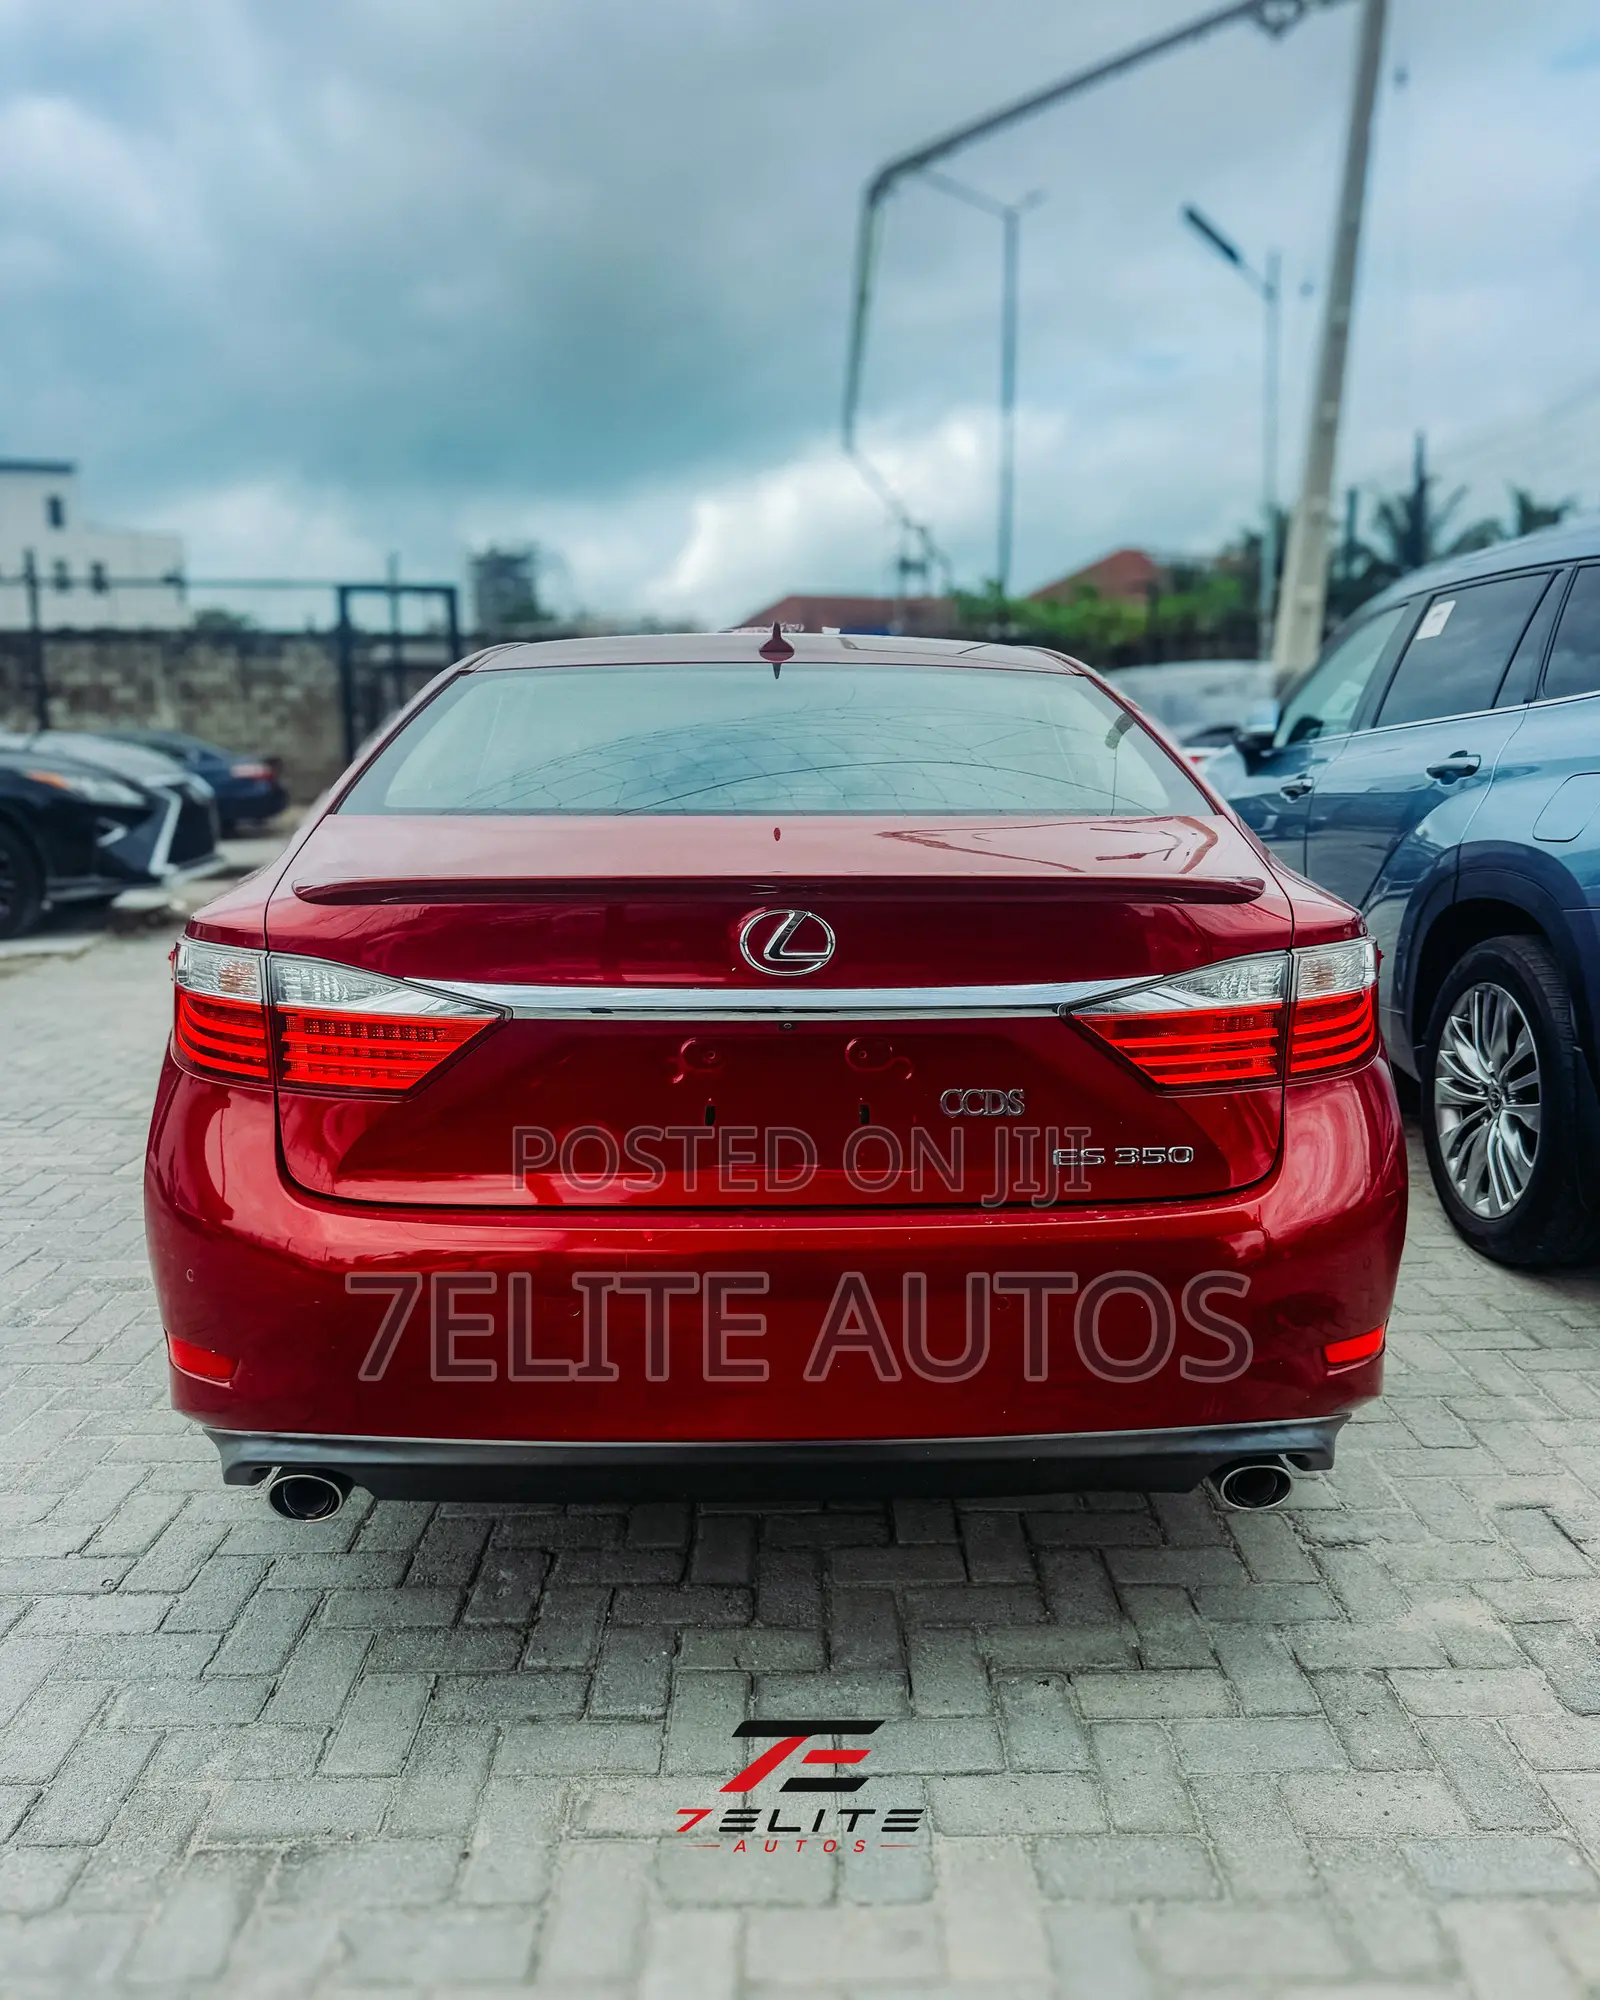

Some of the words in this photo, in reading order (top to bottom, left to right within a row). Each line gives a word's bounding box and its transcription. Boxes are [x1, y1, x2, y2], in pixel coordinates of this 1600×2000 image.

[940, 1088, 1025, 1117] CCDS
[1053, 1148, 1106, 1166] ES
[1114, 1146, 1194, 1165] 350
